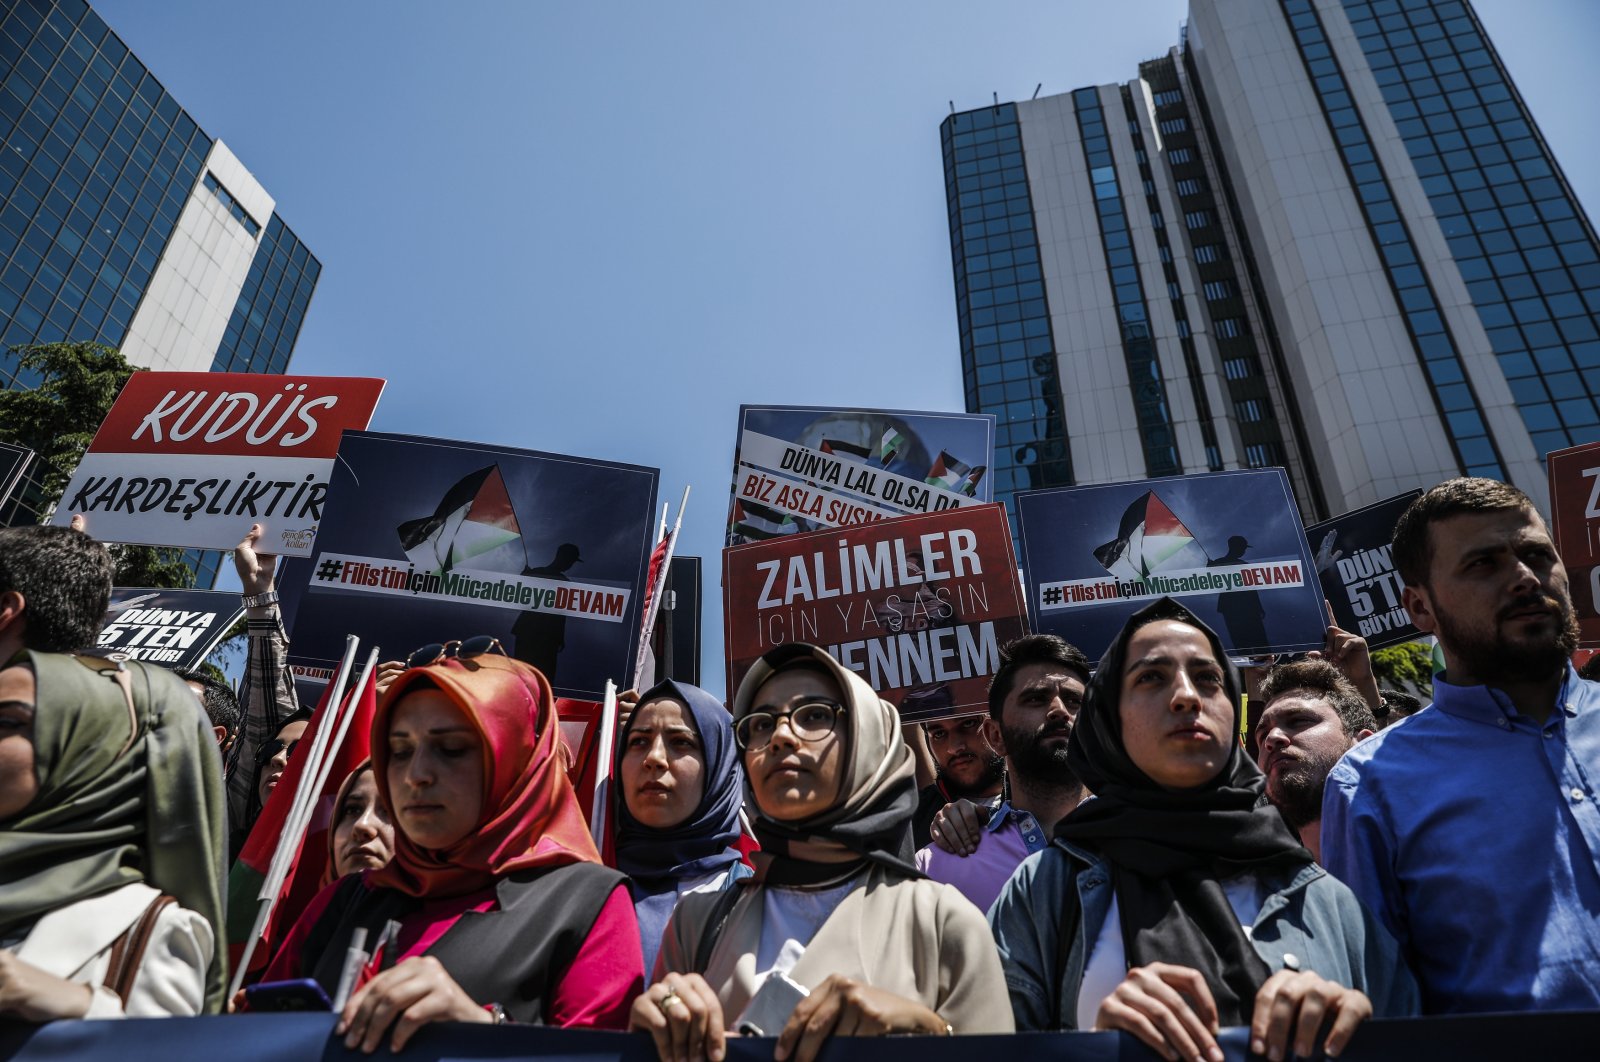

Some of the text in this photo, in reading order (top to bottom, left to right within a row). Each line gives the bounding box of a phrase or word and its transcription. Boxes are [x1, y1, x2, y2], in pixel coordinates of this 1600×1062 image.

[131, 383, 338, 447] KUDÜS
[68, 472, 328, 521] KARDEŞLİKTİR
[743, 473, 777, 503] BİZ
[774, 484, 824, 519] ASLA
[780, 447, 842, 486] DÜNYA
[843, 466, 877, 497] LAL
[881, 477, 930, 513] OLSA
[316, 558, 624, 617] #FilistinİçinMücadeleyeDEVAM
[756, 528, 982, 610] ZALİMLER
[1042, 564, 1301, 605] #FilistinİçinMücadeleyeDEVAM
[113, 608, 217, 628] DÜNYA
[757, 581, 989, 648] İÇİN YAŞASIN
